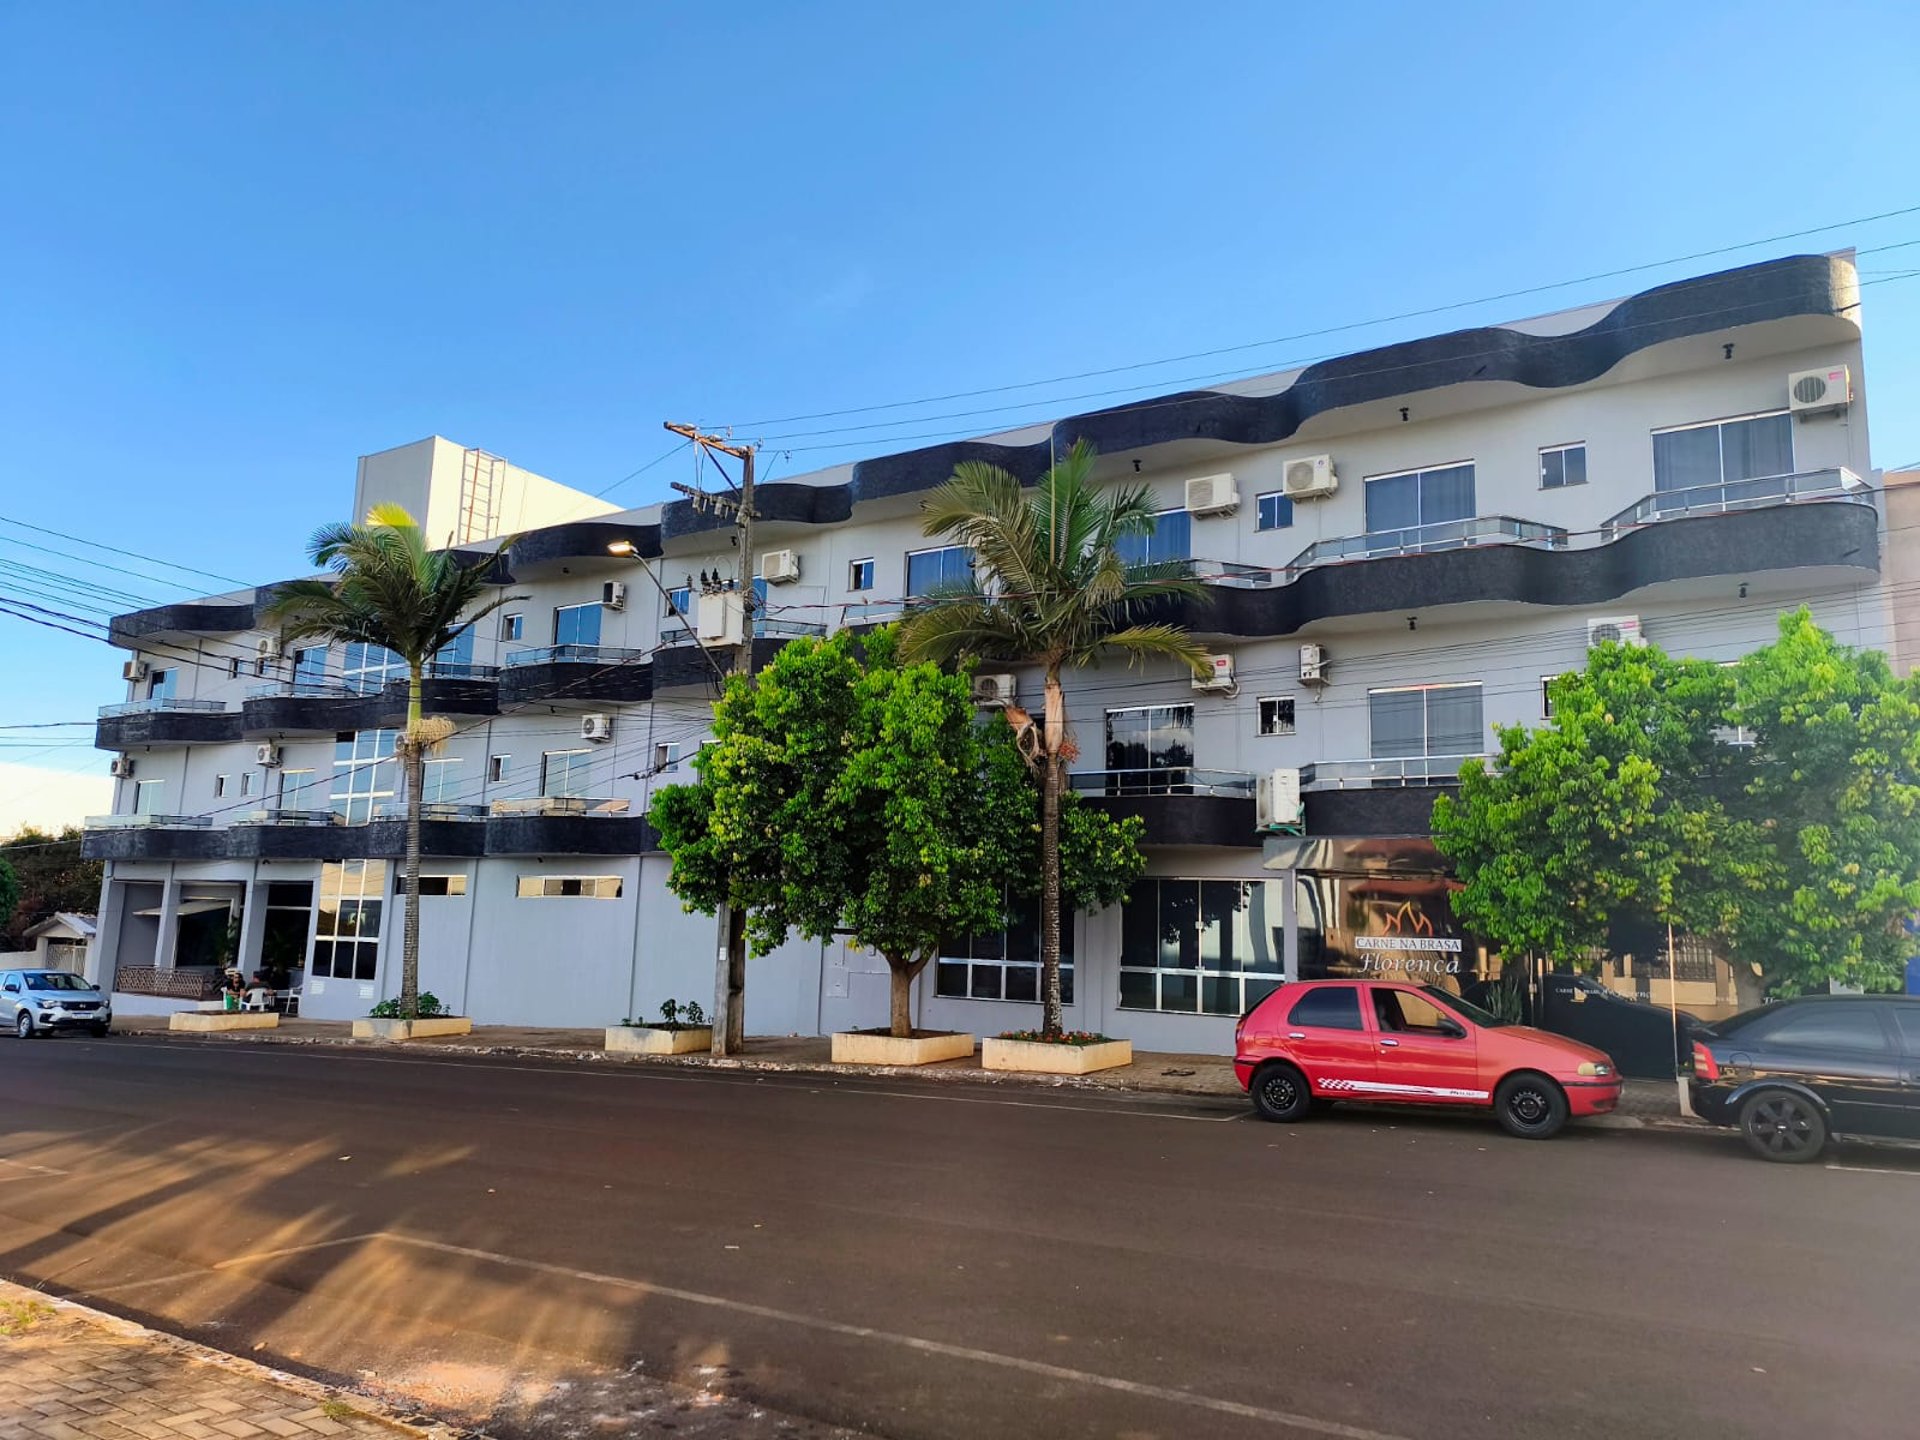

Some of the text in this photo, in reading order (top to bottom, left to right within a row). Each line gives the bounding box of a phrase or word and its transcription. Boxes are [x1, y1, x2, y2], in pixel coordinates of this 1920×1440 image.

[1356, 938, 1460, 950] CARNE NA BRASA
[1357, 952, 1461, 976] Florença
